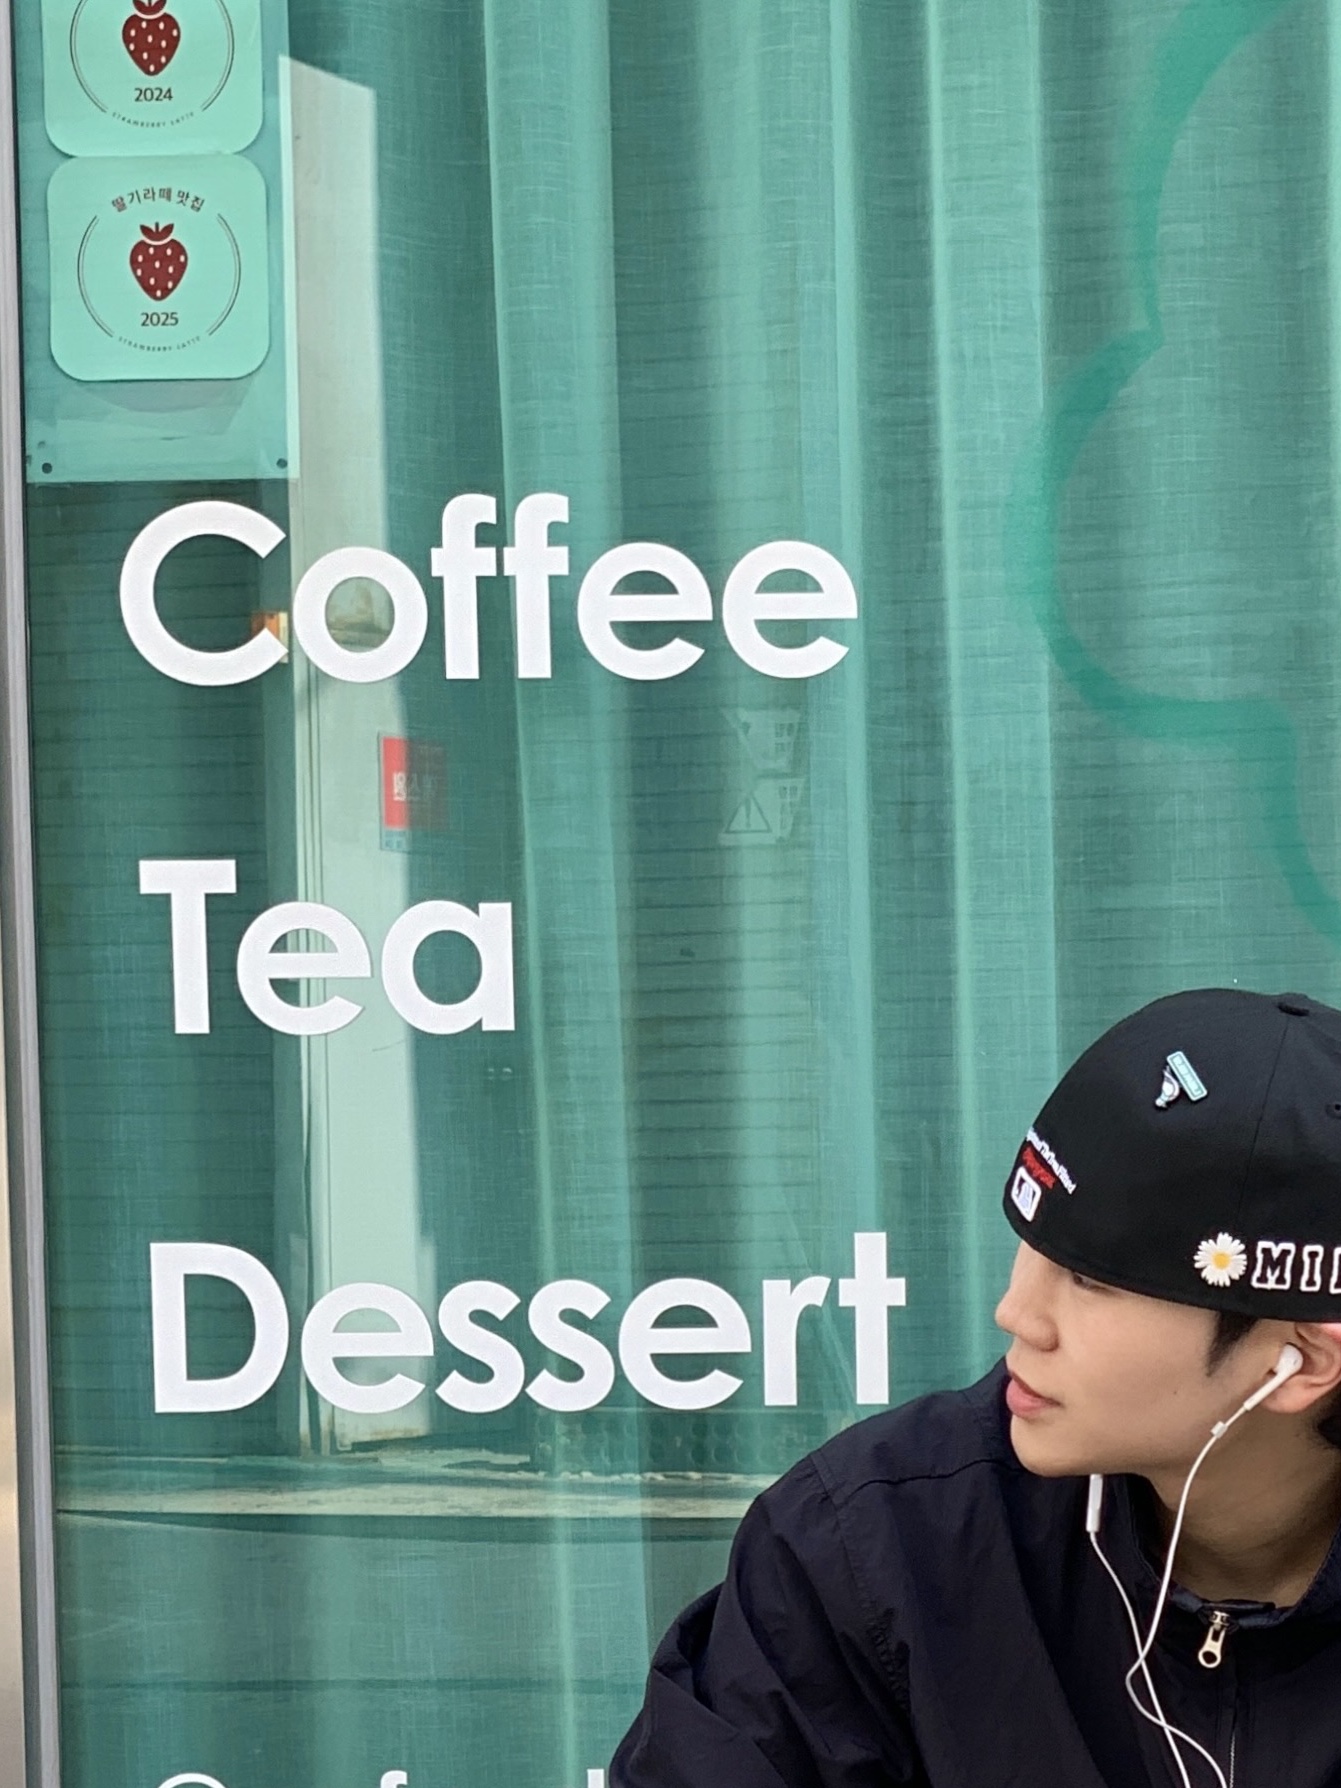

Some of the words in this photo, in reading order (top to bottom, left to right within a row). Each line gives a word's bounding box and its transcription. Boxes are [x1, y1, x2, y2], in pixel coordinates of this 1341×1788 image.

[134, 87, 173, 102] 2024
[111, 187, 172, 213] 딸기라떼
[176, 190, 205, 213] 맛집
[140, 312, 179, 327] 2025
[120, 492, 858, 686] Coffee
[139, 859, 515, 1036] Tea
[150, 1232, 906, 1414] Dessert
